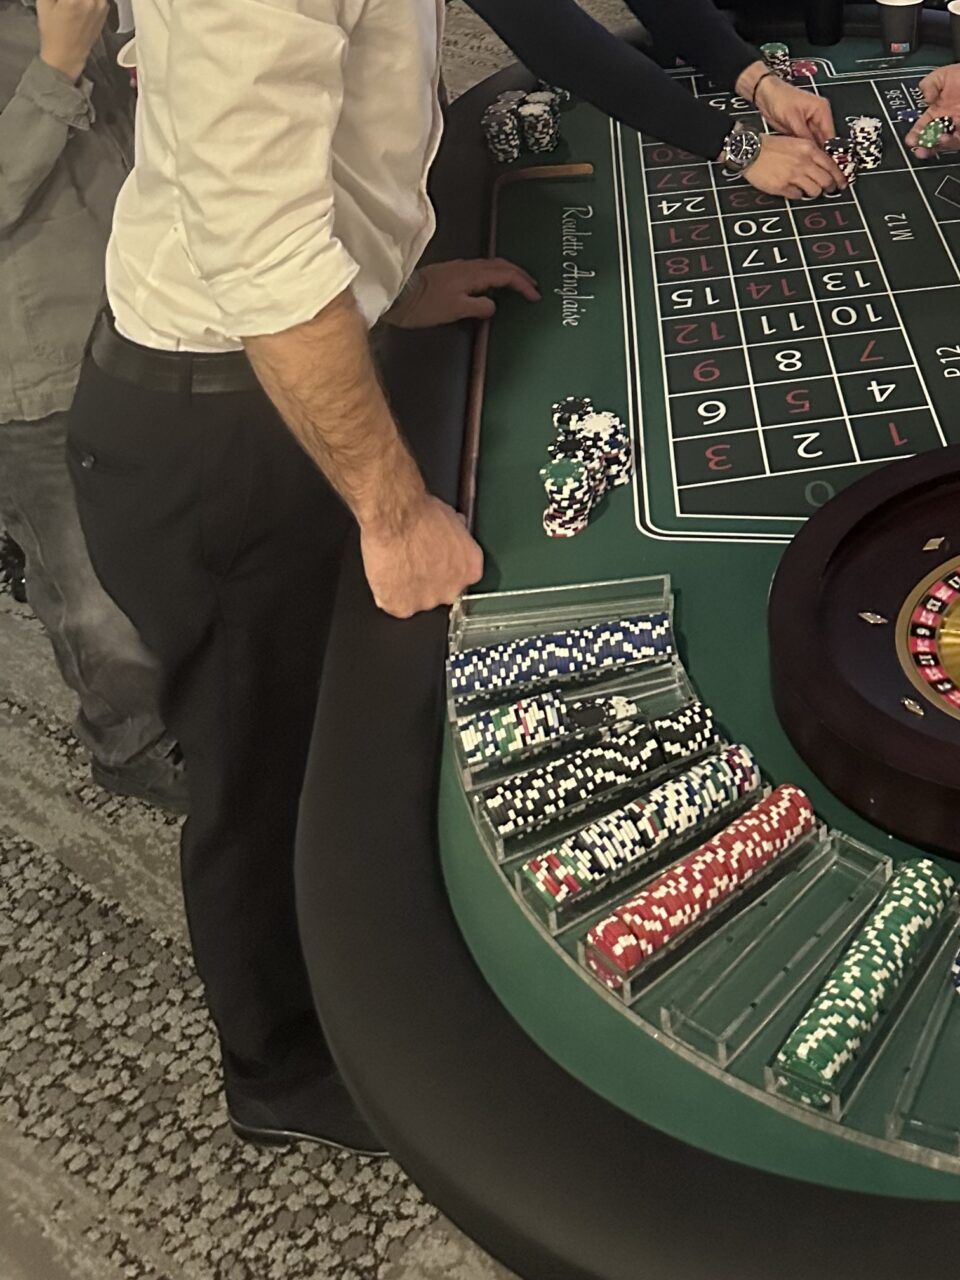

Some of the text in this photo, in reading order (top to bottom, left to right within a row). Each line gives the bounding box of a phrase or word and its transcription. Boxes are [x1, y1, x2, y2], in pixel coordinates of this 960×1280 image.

[656, 170, 700, 189] 27
[657, 196, 706, 216] 24
[733, 216, 783, 237] 20
[804, 210, 849, 229] 19
[668, 223, 711, 243] 21
[741, 246, 788, 268] 17
[812, 239, 861, 259] 16
[553, 205, 596, 327] Roulette Anglaise
[665, 254, 714, 275] 18
[746, 278, 798, 300] 14
[822, 270, 872, 291] 13
[671, 286, 720, 309] 15
[760, 312, 805, 335] 11
[830, 303, 883, 326] 10
[674, 320, 726, 345] 12
[774, 349, 803, 372] 8
[859, 339, 885, 363] 7
[692, 358, 721, 382] 9
[785, 389, 811, 414] 5
[866, 380, 896, 403] 4
[697, 400, 727, 426] 6
[792, 431, 824, 458] 2
[888, 422, 909, 446] 1
[704, 444, 733, 470] 3
